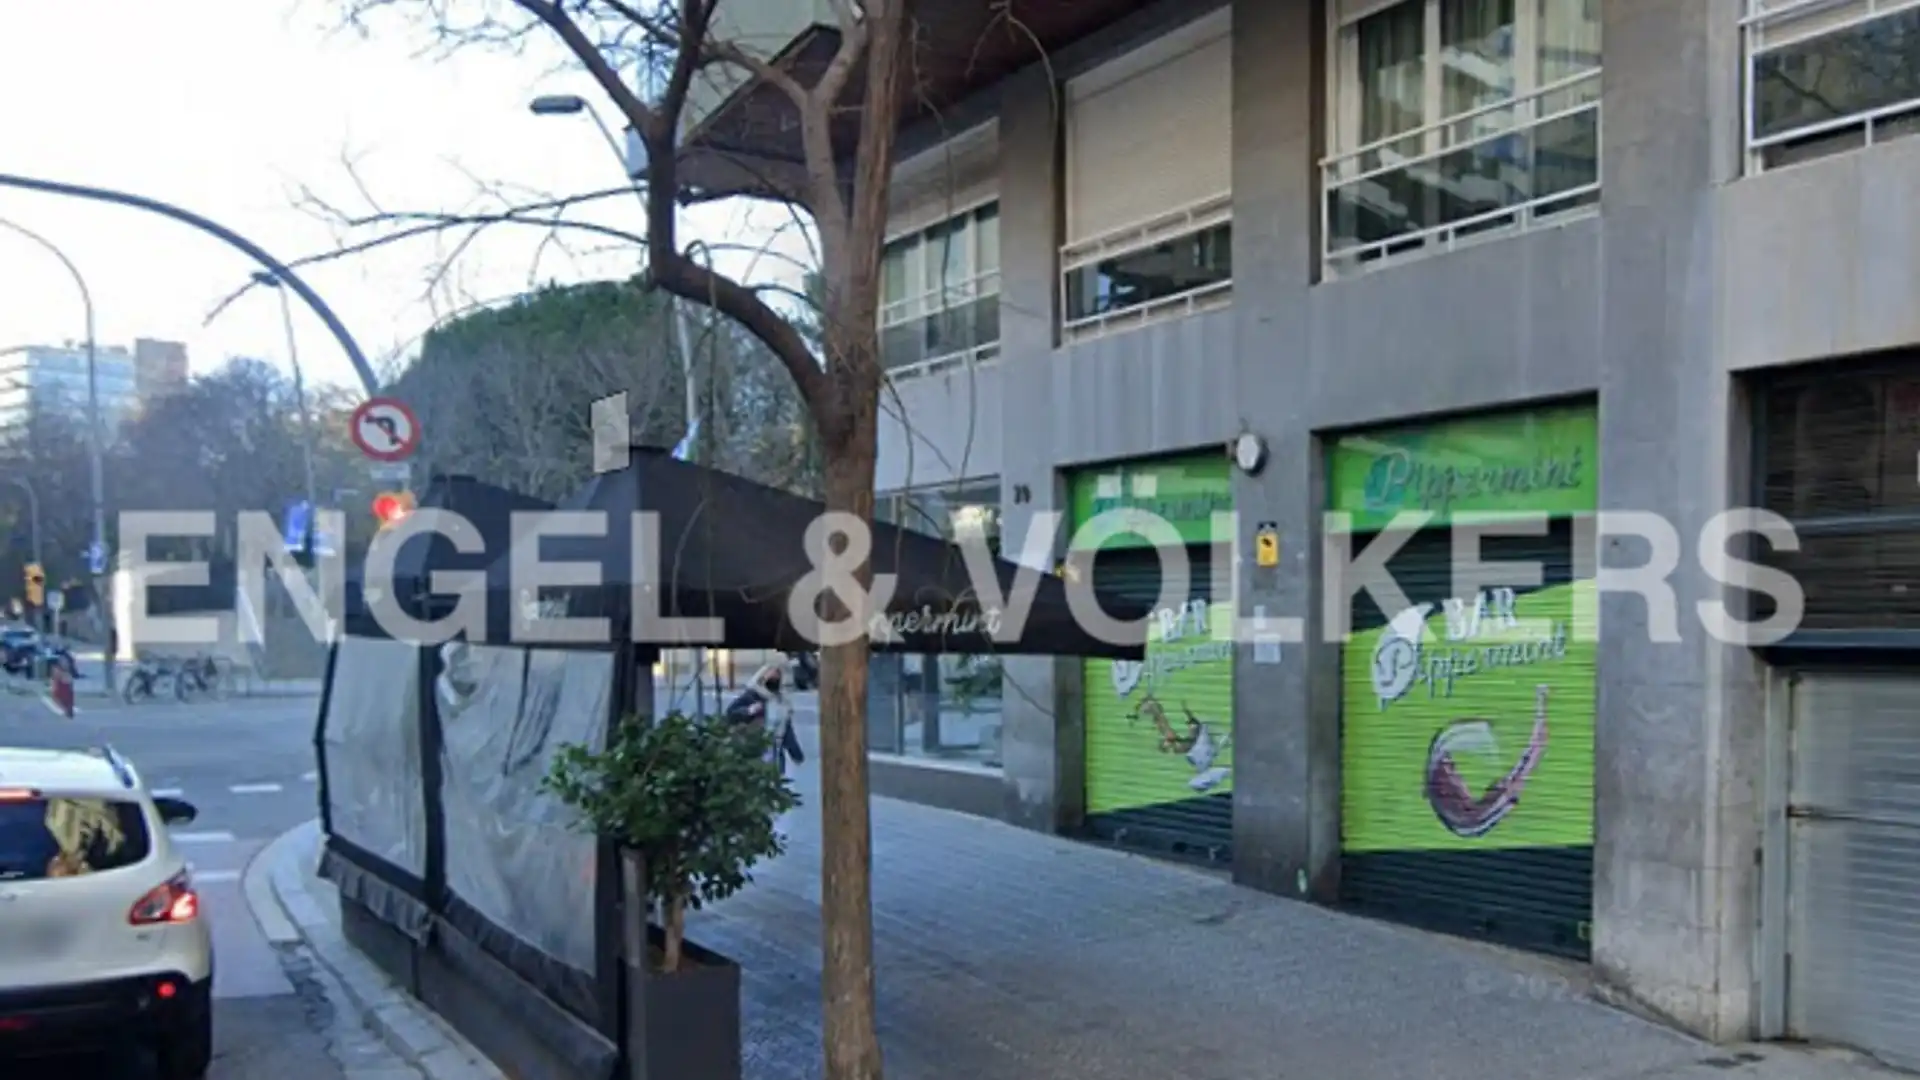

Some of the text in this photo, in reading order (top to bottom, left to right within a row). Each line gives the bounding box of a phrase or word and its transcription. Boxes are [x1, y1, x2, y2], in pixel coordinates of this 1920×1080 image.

[867, 604, 1001, 646] ppermint
[1158, 598, 1209, 643] BAR
[1442, 587, 1518, 640] BAR
